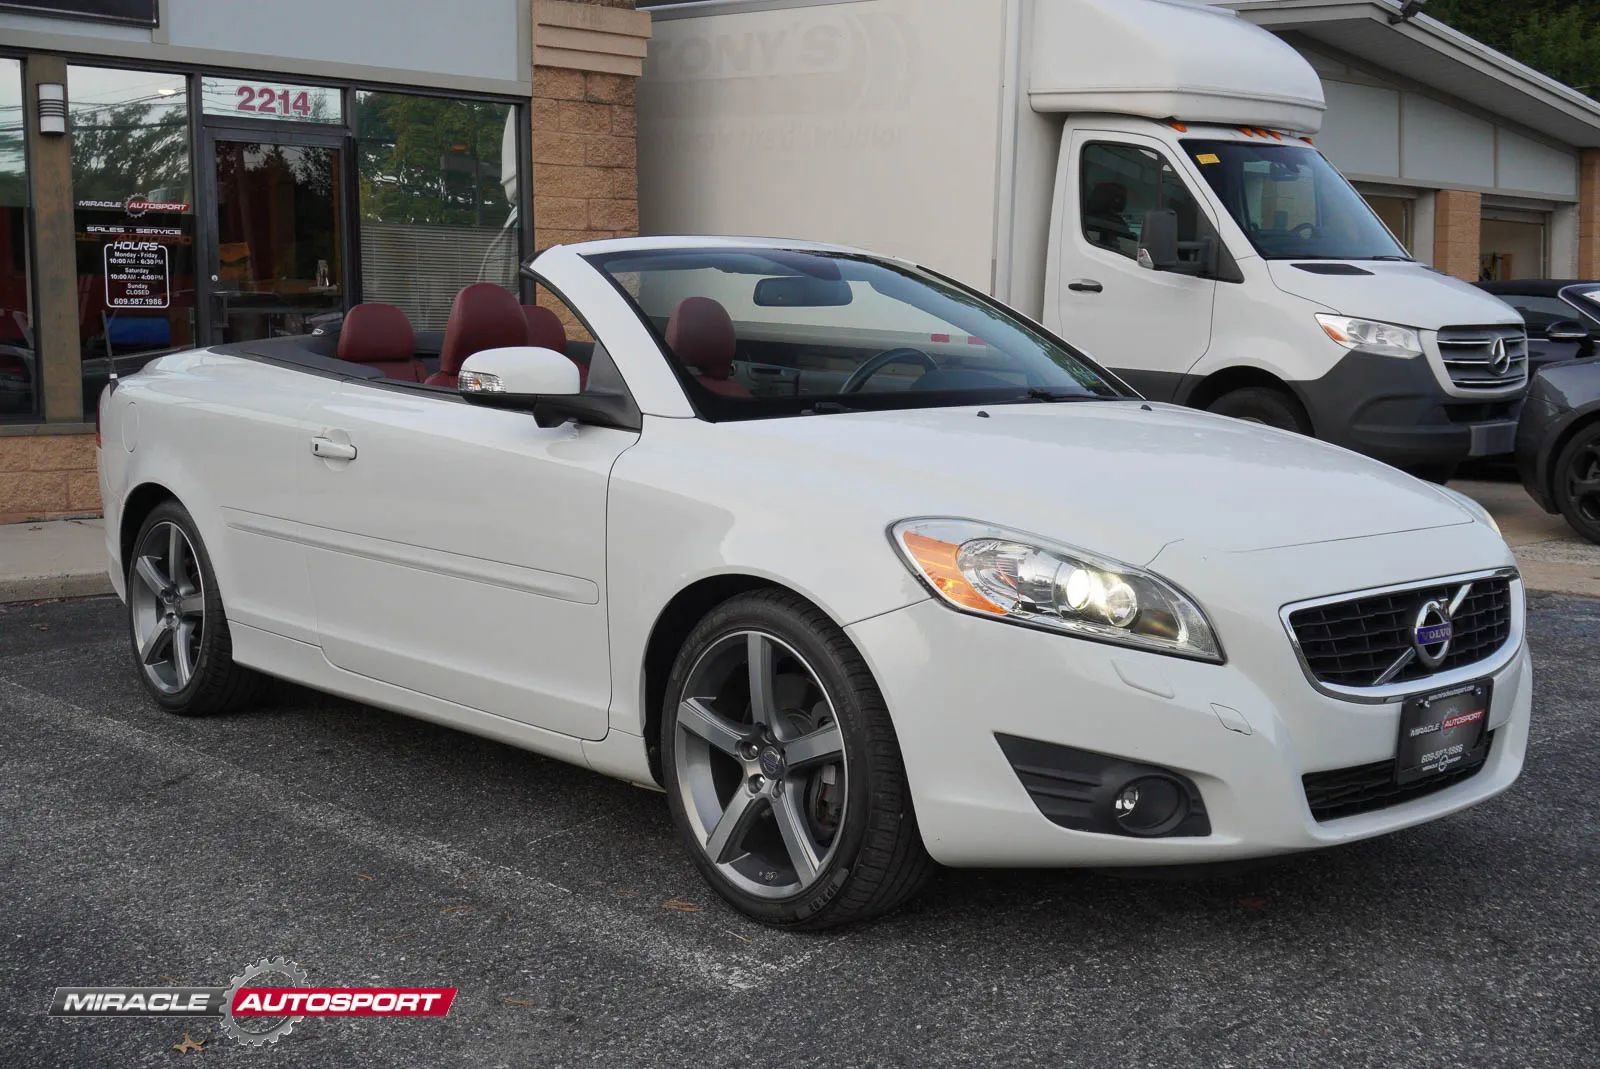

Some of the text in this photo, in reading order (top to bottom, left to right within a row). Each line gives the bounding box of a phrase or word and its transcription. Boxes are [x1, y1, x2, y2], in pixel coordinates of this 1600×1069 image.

[236, 86, 311, 116] 2214
[79, 200, 187, 210] MIRACLE AUTOSPORT
[113, 241, 159, 251] HOURS
[114, 251, 137, 259] Monday
[1421, 628, 1451, 640] VOLVO
[1410, 711, 1482, 737] MIRACLE AUTOSPORT
